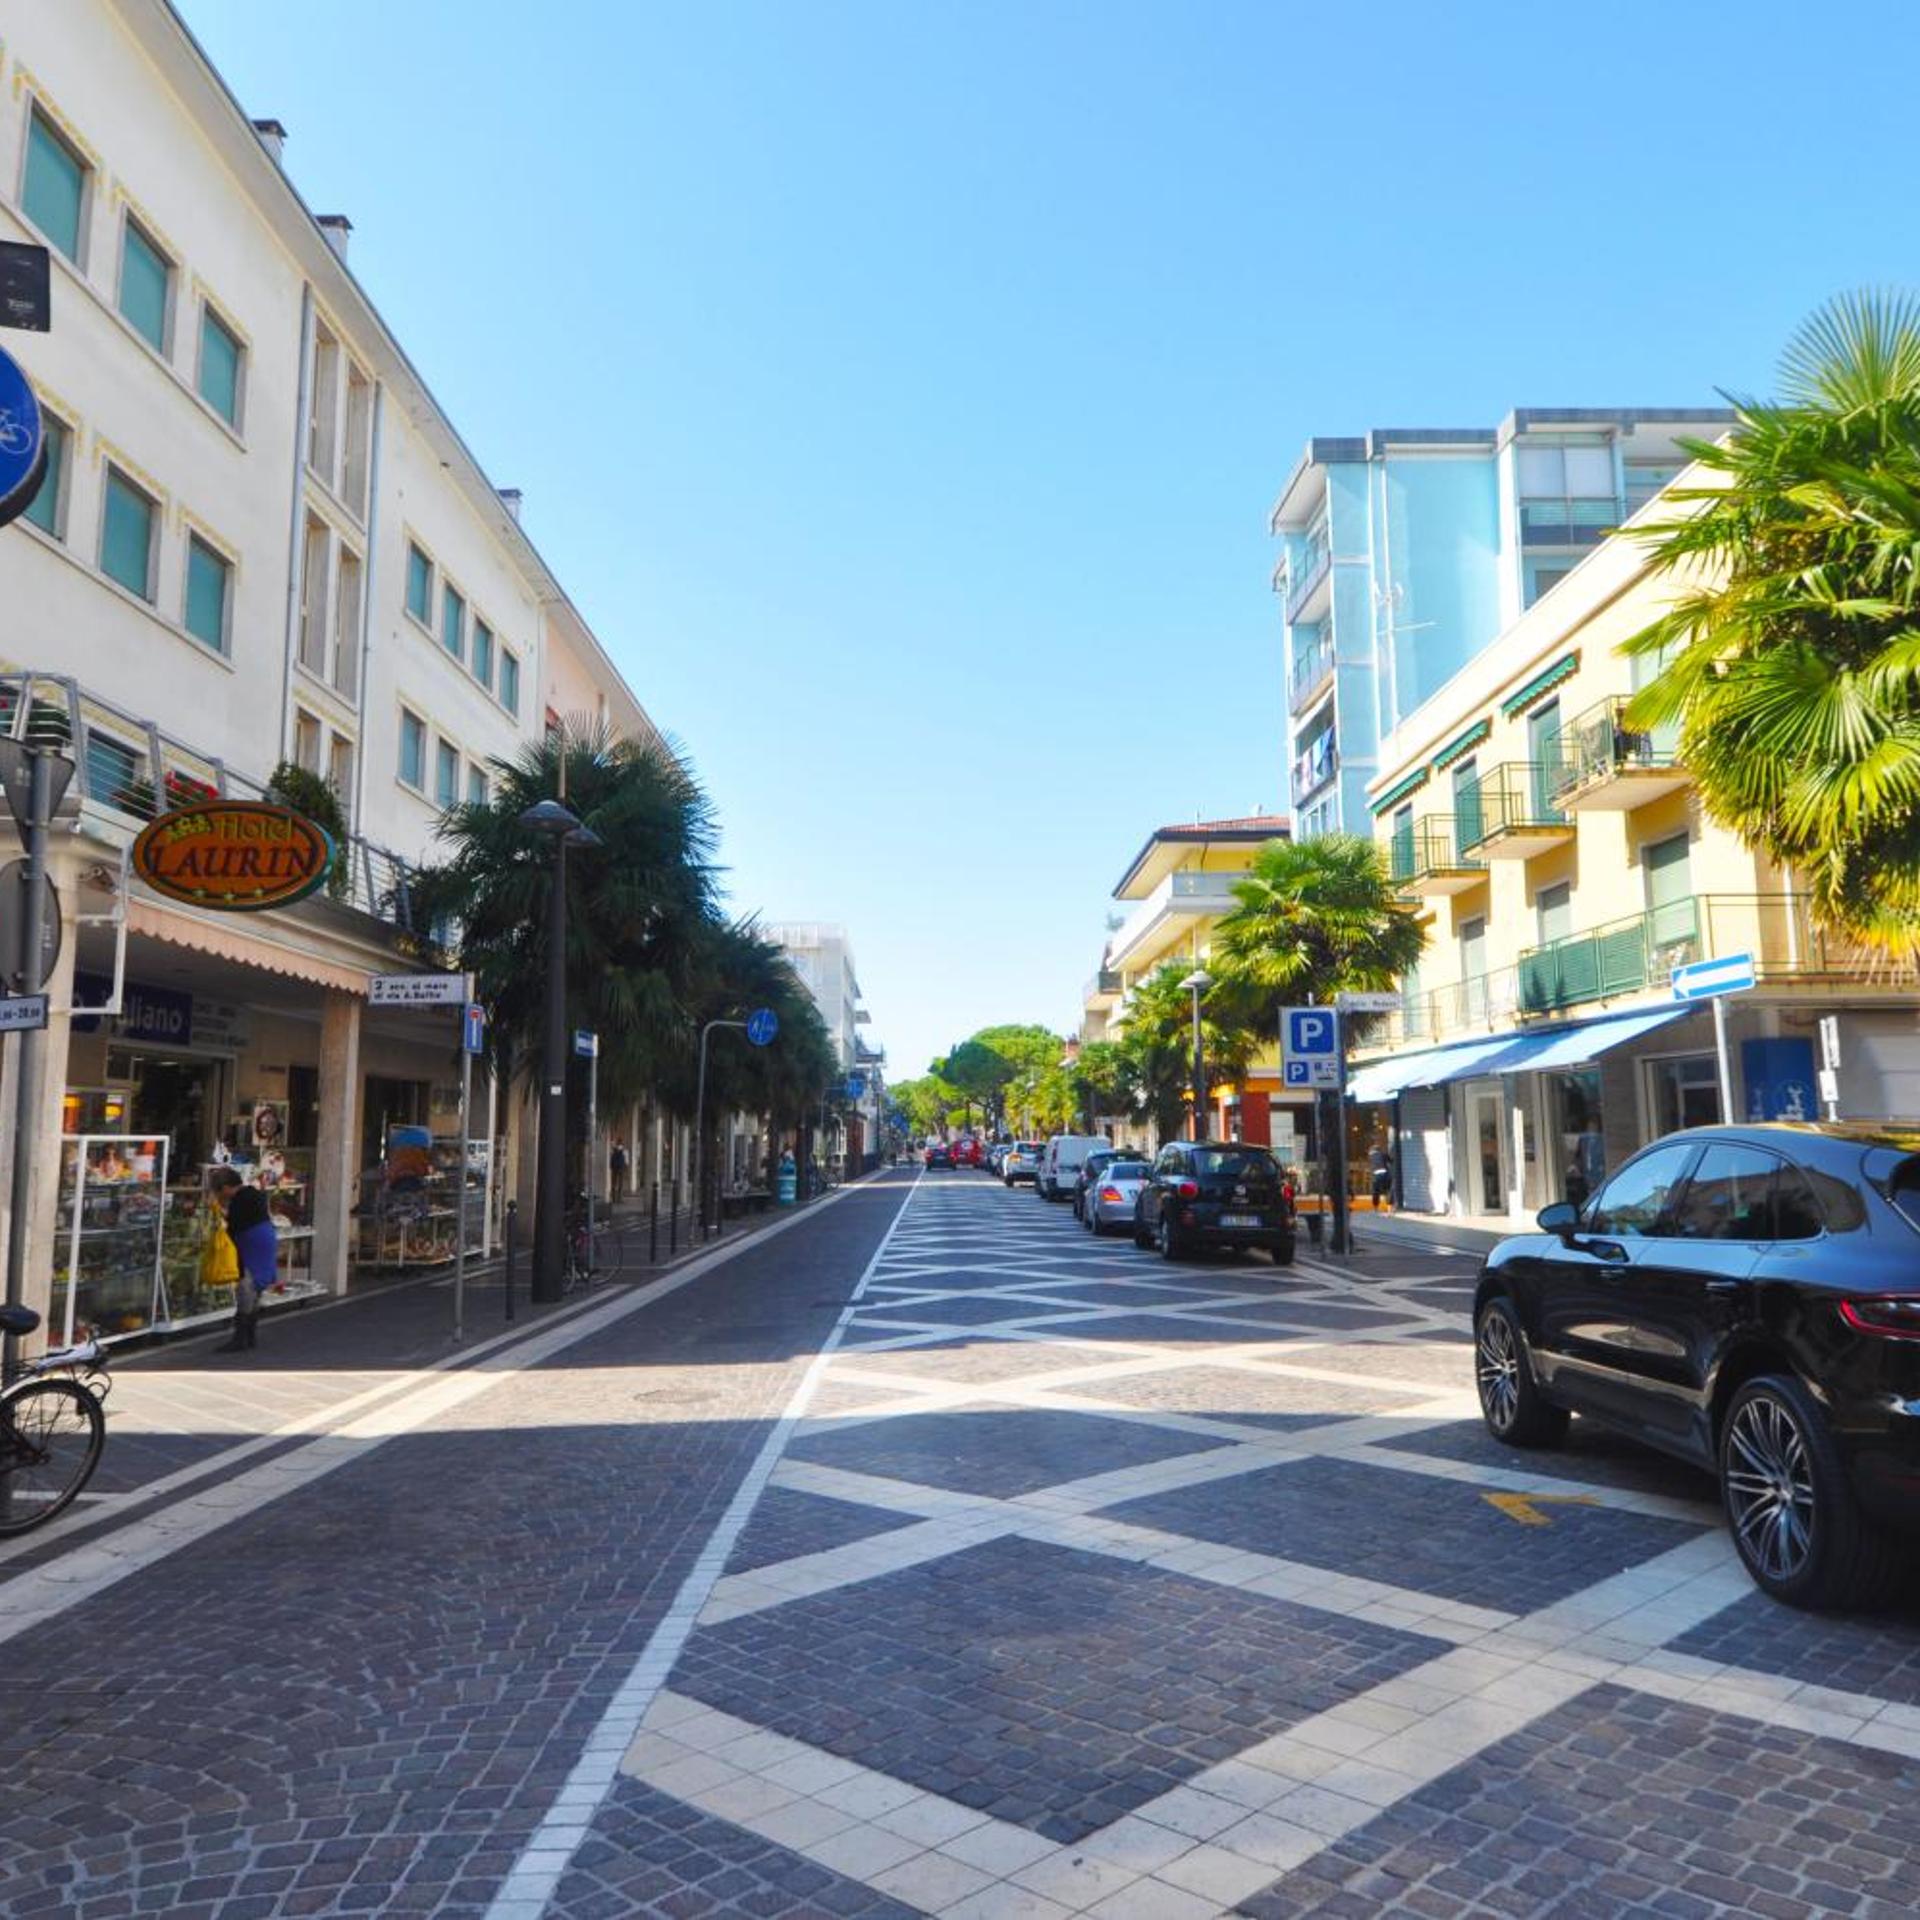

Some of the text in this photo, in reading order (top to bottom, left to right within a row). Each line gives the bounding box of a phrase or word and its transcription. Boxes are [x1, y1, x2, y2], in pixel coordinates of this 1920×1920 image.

[218, 814, 292, 841] Hotel
[147, 846, 316, 878] LAURIN
[1300, 1017, 1324, 1048] P
[1291, 1063, 1304, 1080] P
